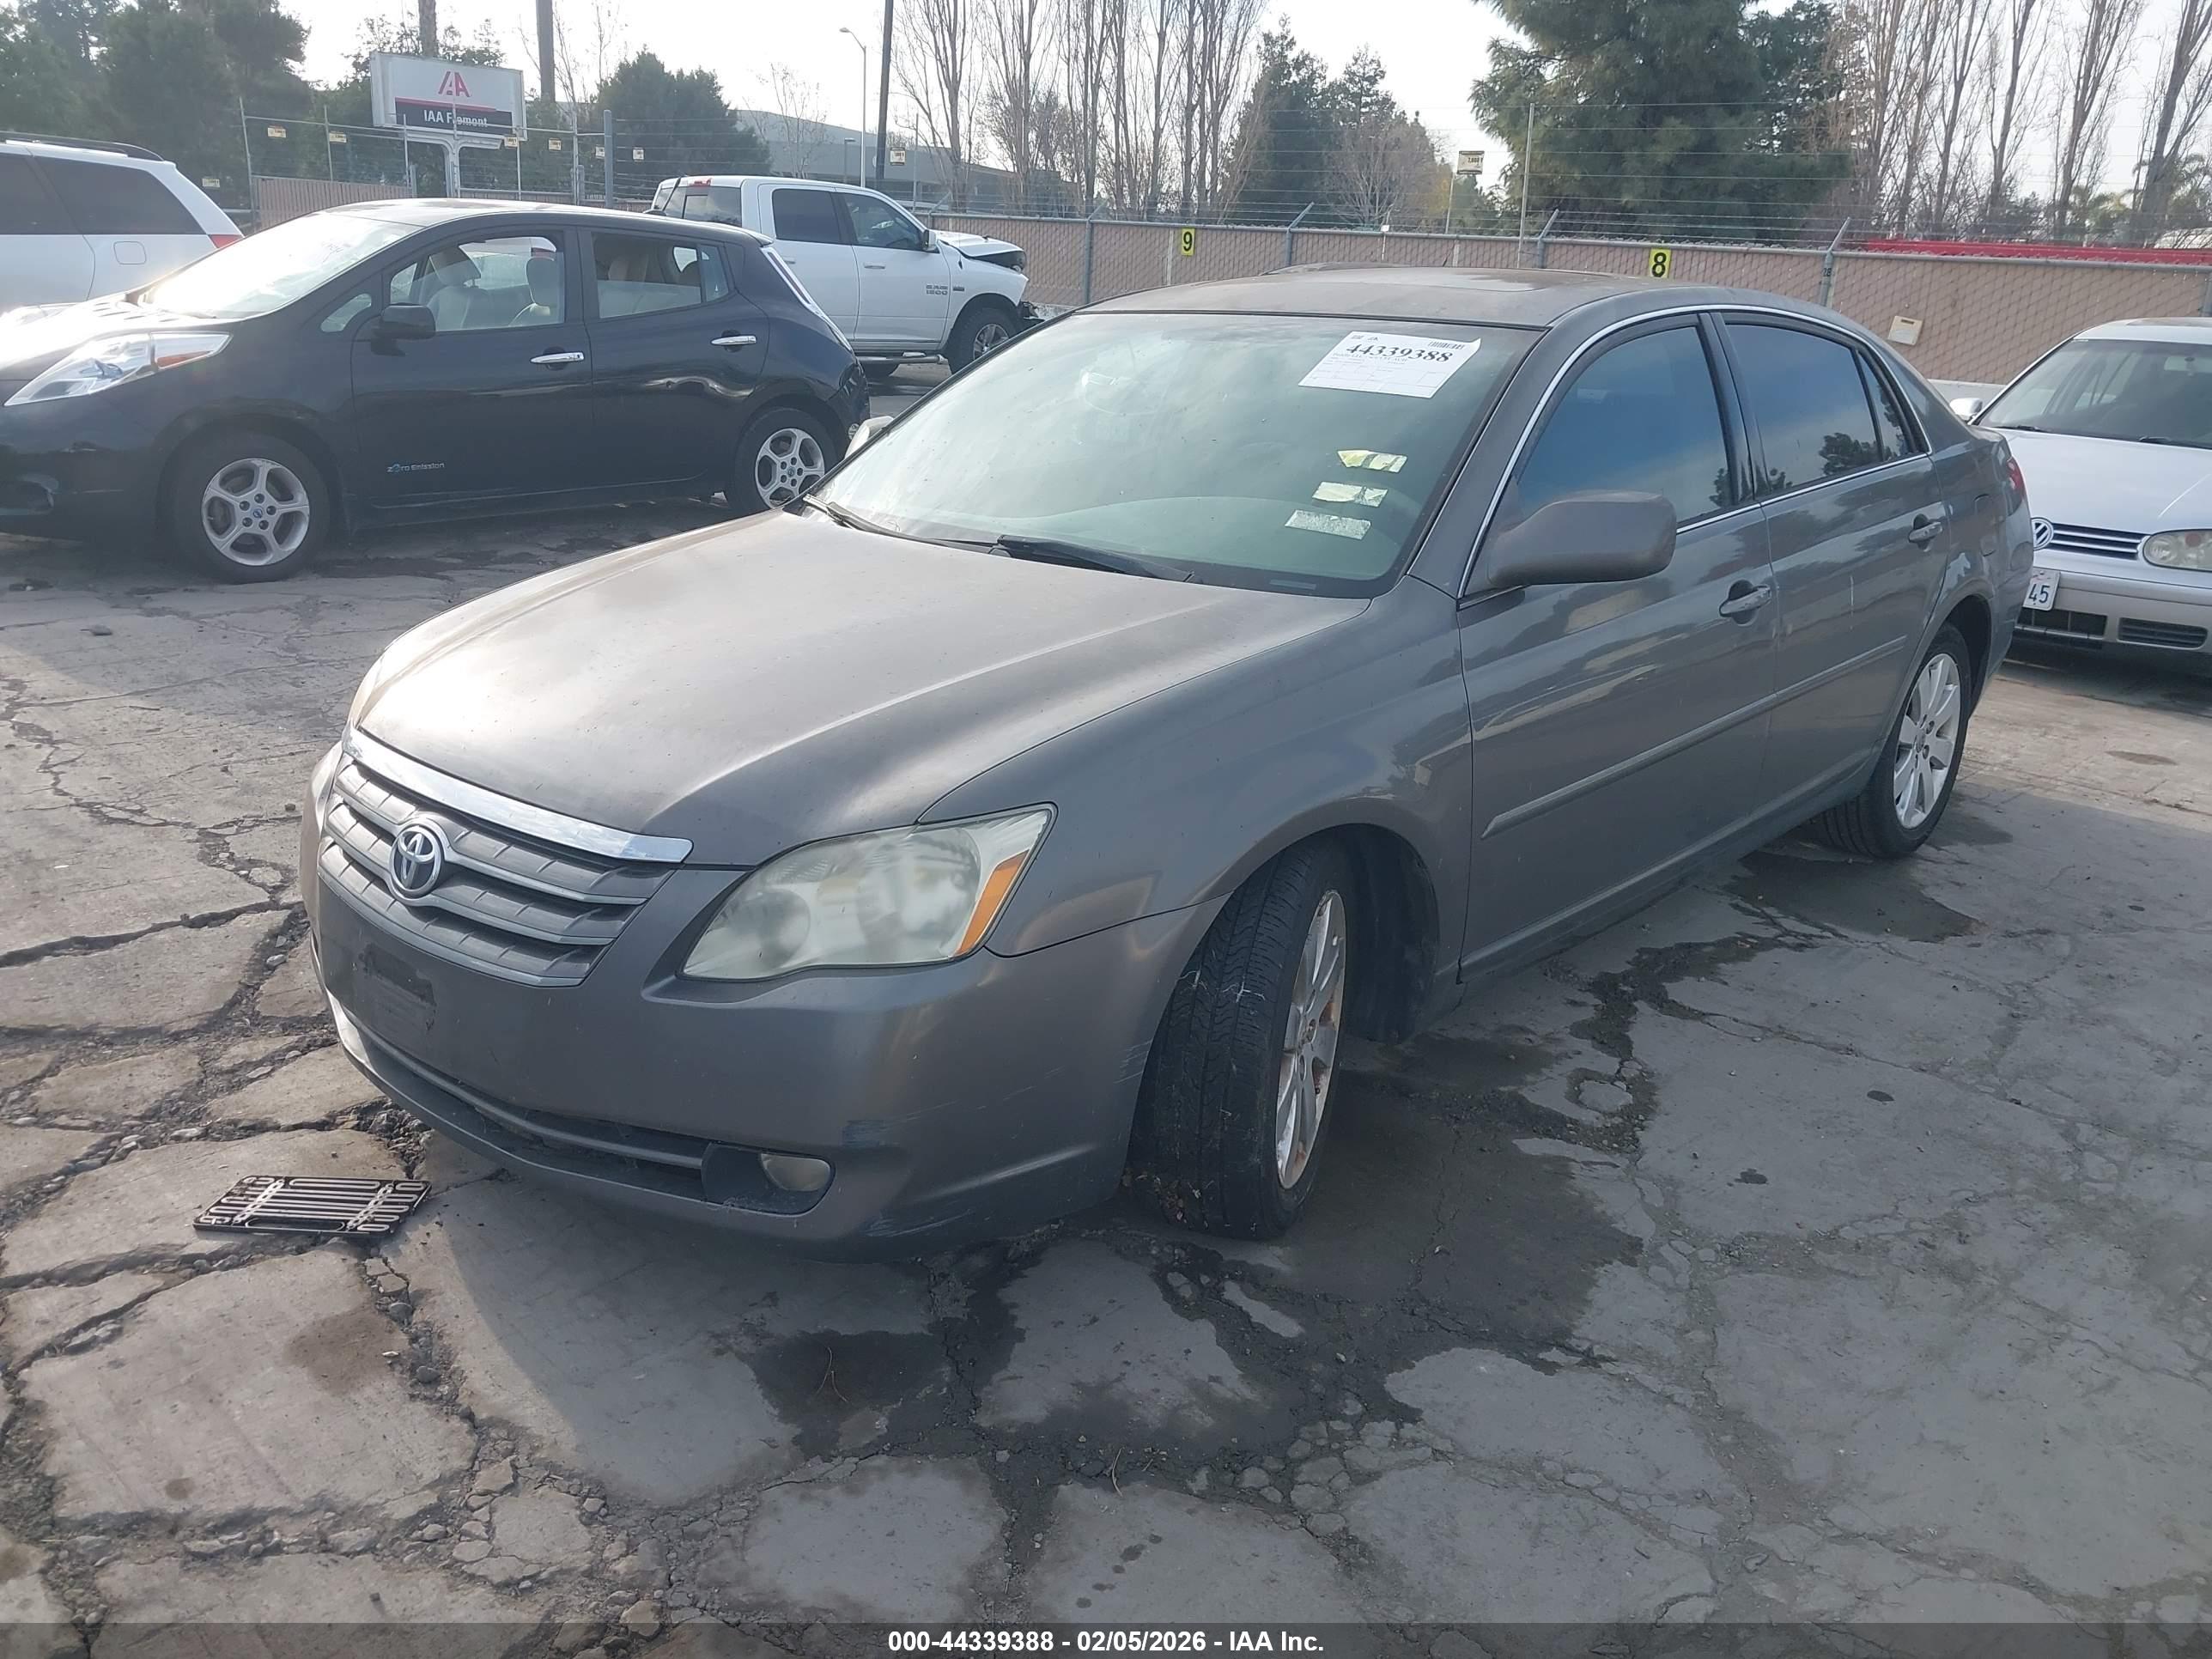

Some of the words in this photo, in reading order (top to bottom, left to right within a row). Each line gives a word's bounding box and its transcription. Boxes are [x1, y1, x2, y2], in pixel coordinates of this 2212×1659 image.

[423, 108, 444, 124] IAA
[446, 112, 488, 127] Femont
[1183, 231, 1193, 252] 9
[1651, 252, 1667, 277] 8
[1346, 343, 1453, 362] 44339388
